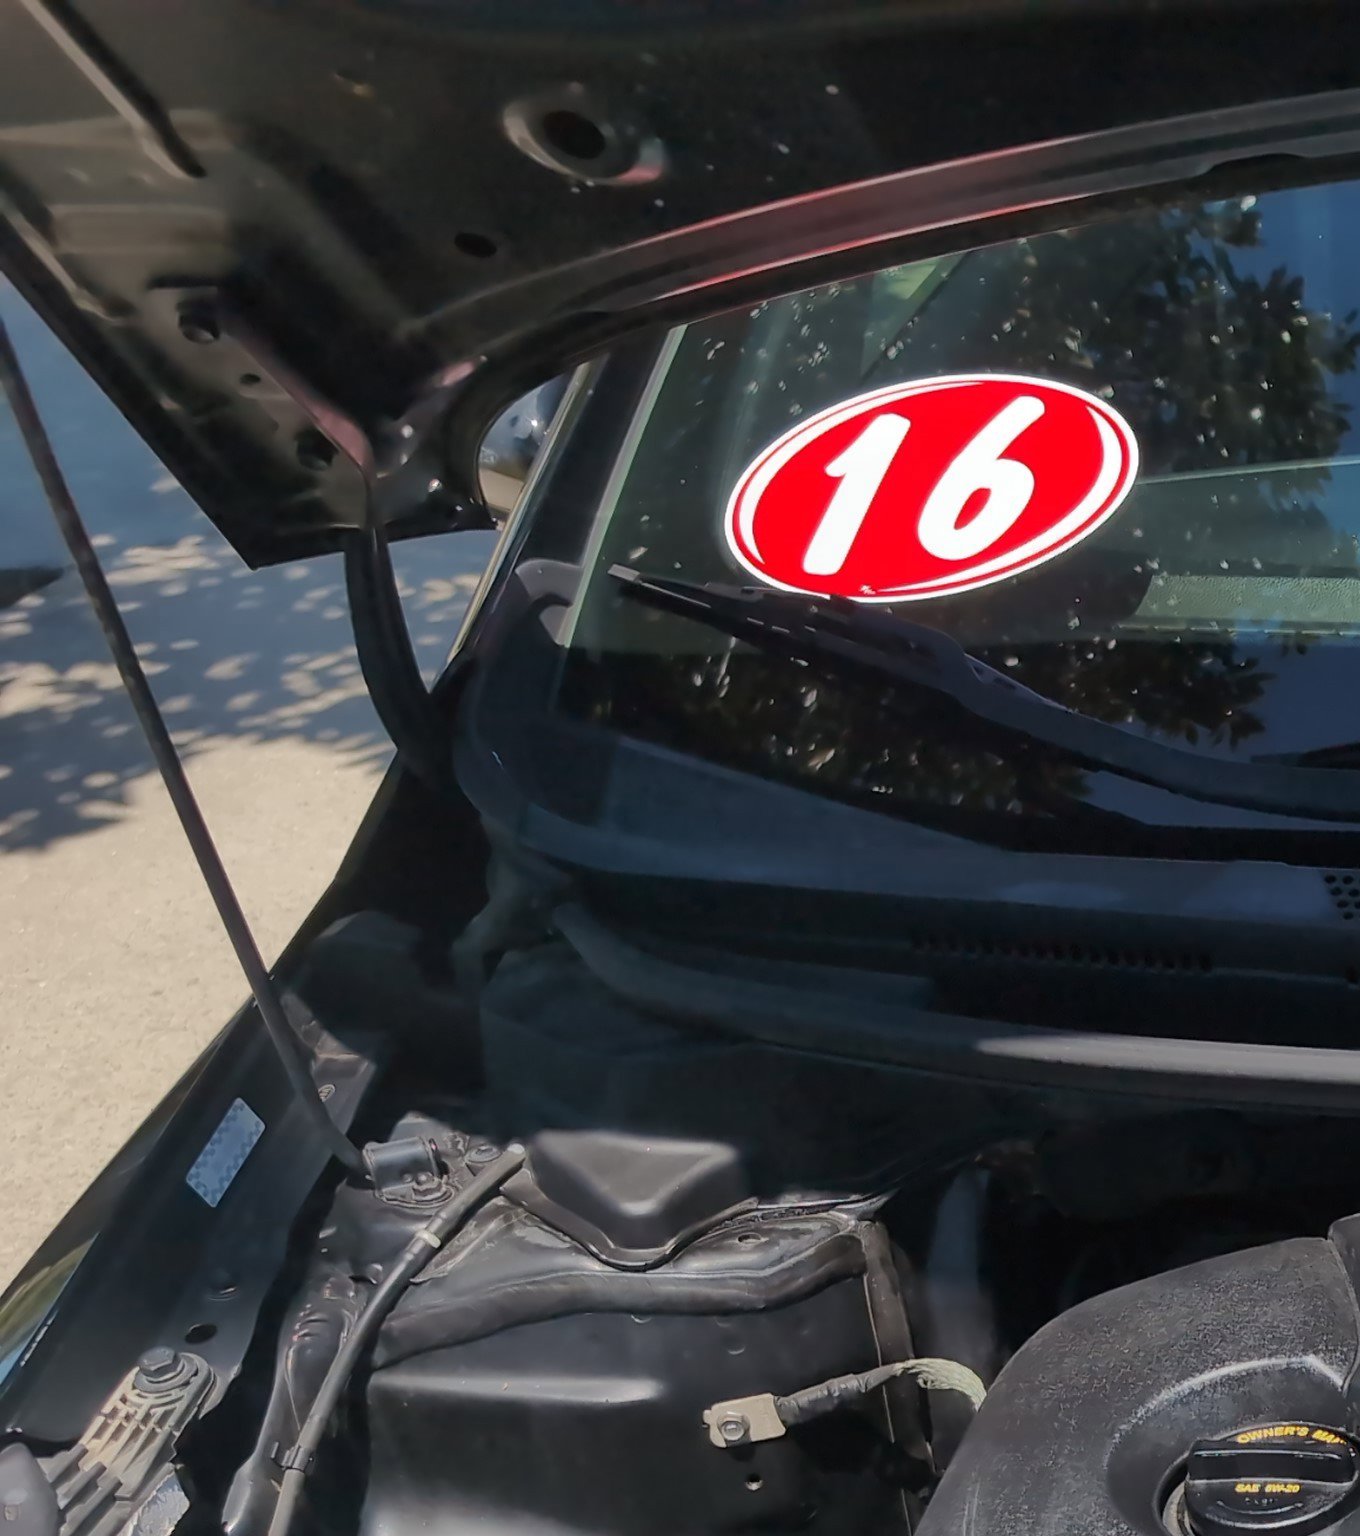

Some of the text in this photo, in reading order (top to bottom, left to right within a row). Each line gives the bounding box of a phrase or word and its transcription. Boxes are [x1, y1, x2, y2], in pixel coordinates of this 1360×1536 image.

[802, 395, 1045, 575] 16
[1235, 1426, 1310, 1444] OWNER'S
[1235, 1483, 1260, 1493] SAE
